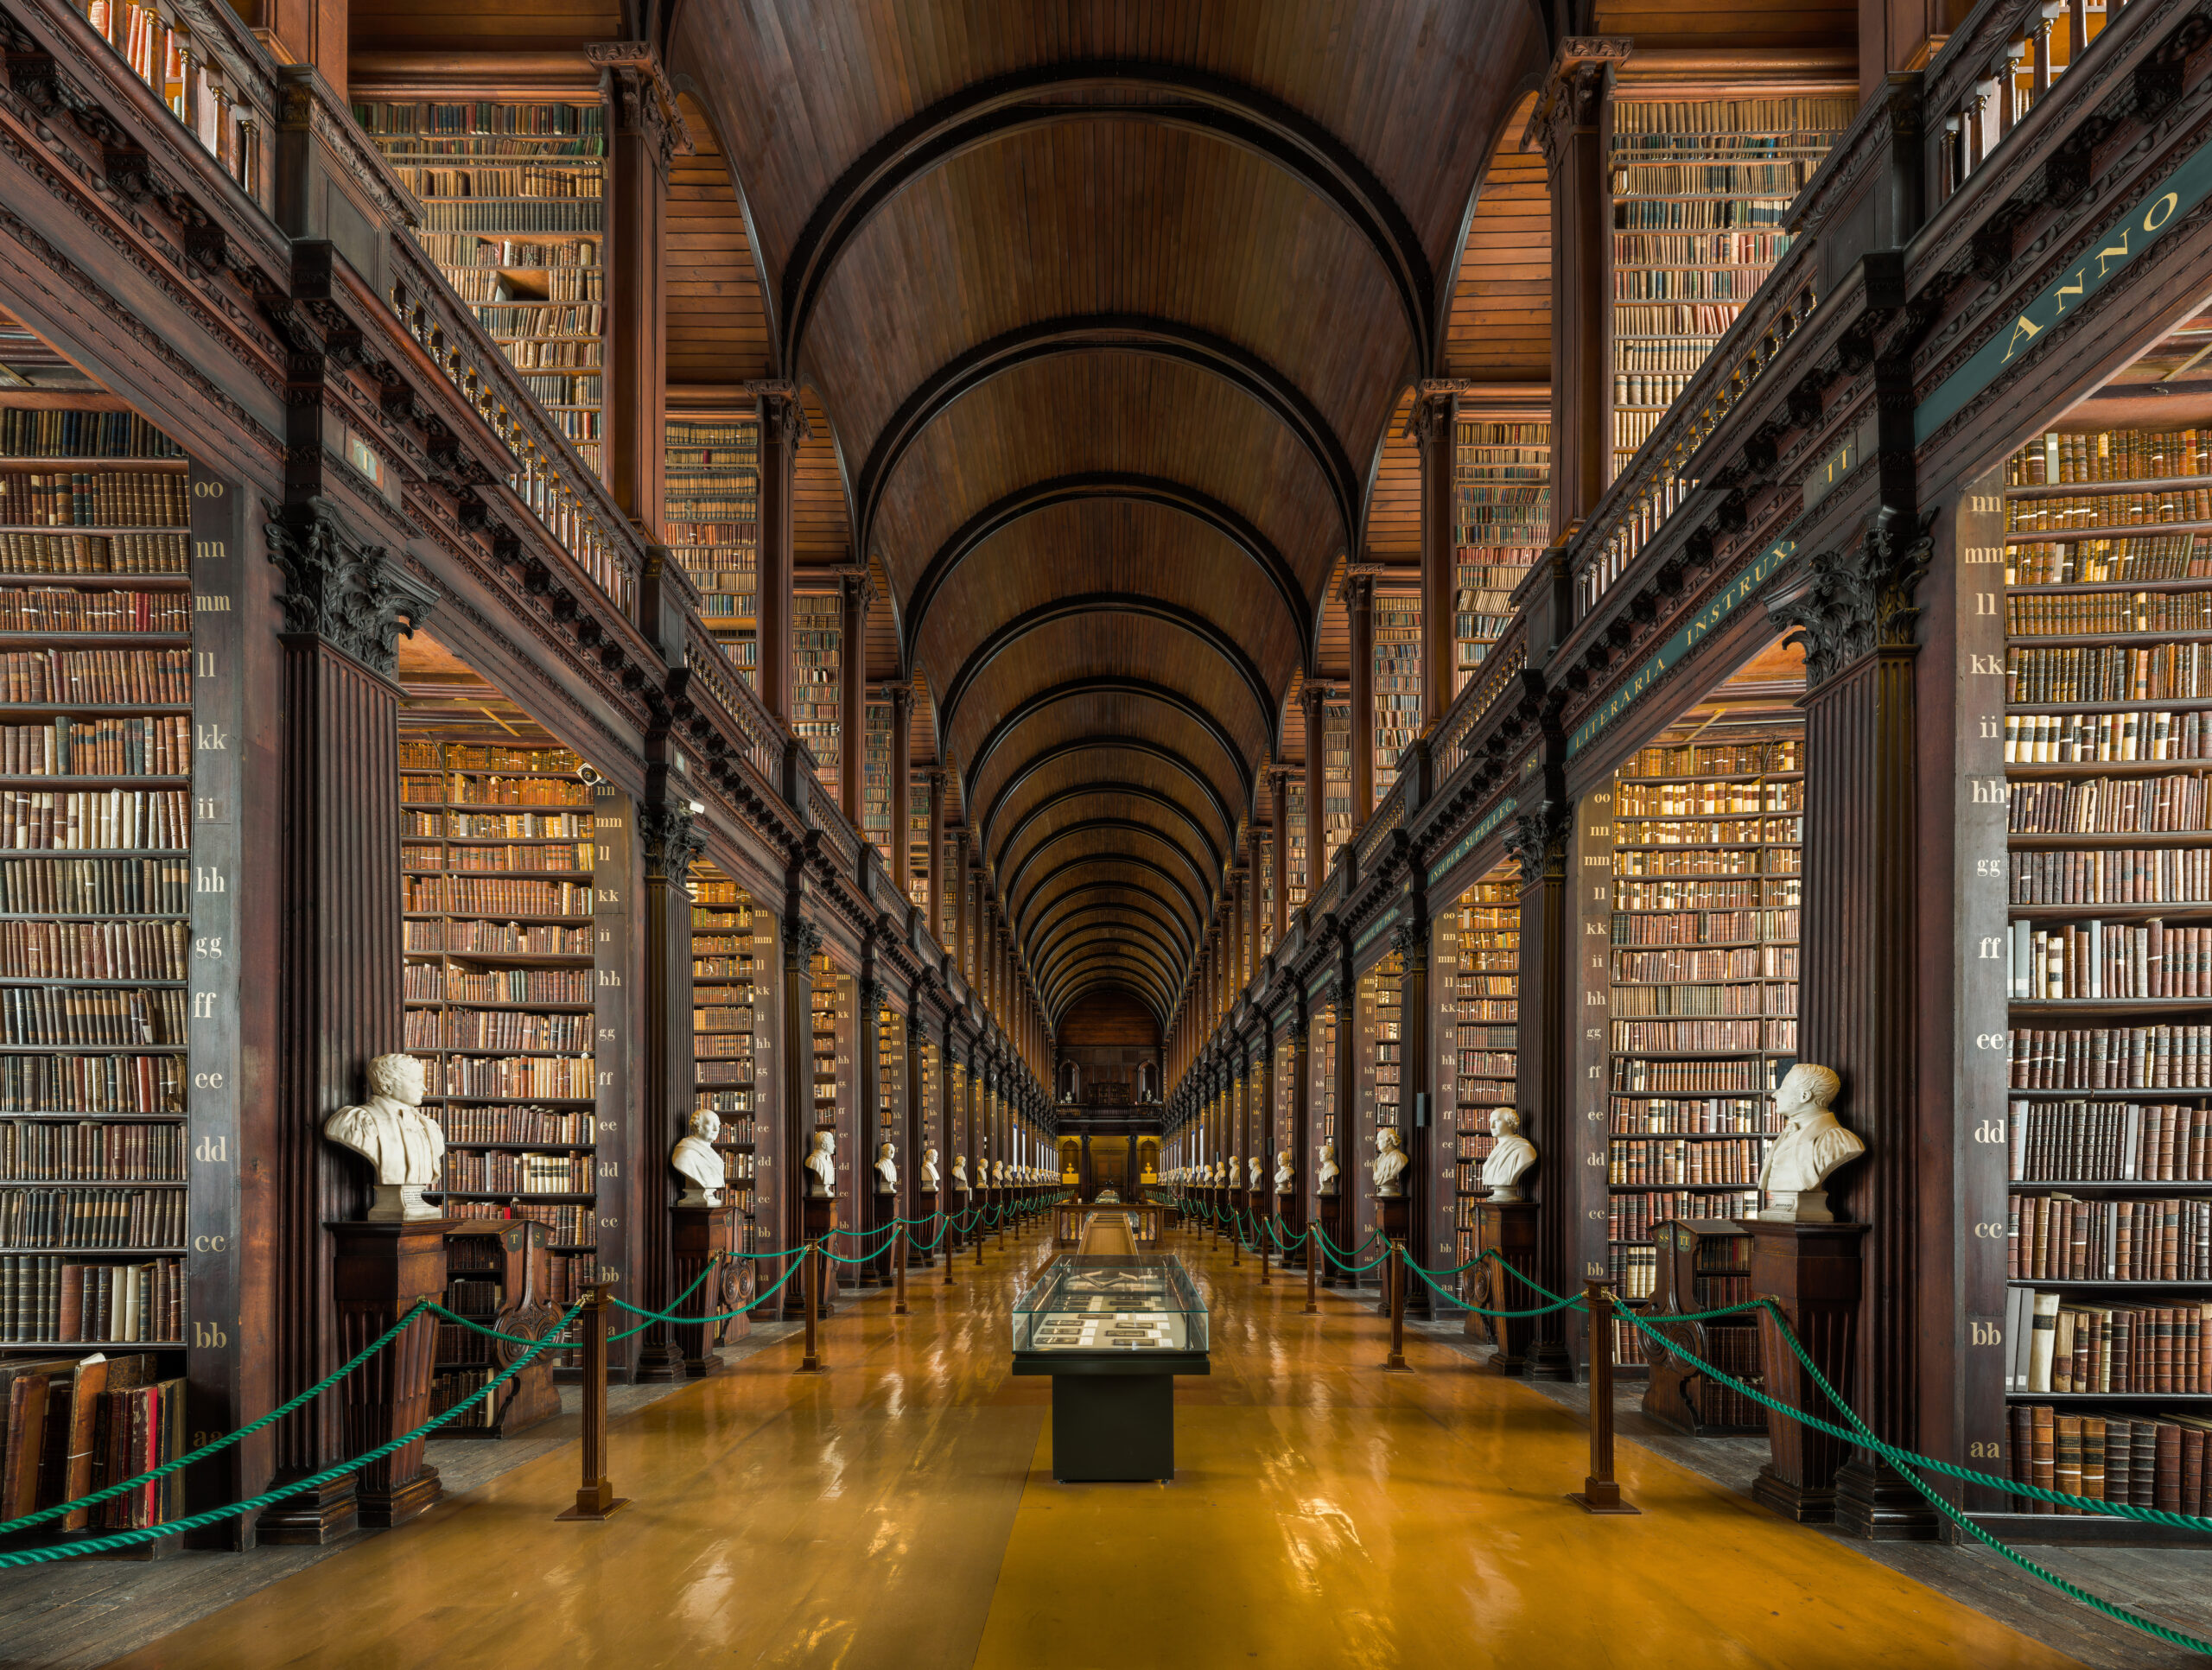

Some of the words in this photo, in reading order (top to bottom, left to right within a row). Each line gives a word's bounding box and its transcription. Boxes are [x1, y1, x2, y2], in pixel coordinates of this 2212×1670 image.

[2001, 192, 2177, 364] ANNO
[1823, 444, 1851, 483] TT
[195, 482, 224, 498] oo
[1970, 495, 2002, 512] nn
[195, 541, 226, 557] nn
[1965, 546, 2005, 563] mm
[195, 594, 232, 611] mm
[1975, 593, 1998, 615] ll
[198, 652, 215, 677] ll
[1970, 655, 2005, 675] kk
[1575, 657, 1665, 749] LITERARIA
[1980, 715, 1999, 738] ii
[197, 725, 226, 749] kk
[597, 786, 615, 796] nn
[1972, 781, 2005, 803] hh
[1595, 794, 1611, 803] oo
[198, 798, 215, 818] ii
[596, 817, 622, 828] mm
[1590, 826, 1610, 836] nn
[598, 846, 610, 860] ll
[1431, 848, 1460, 883] INSUPER
[1585, 855, 1610, 866] mm
[1977, 859, 2001, 878] gg
[196, 867, 225, 892] hh
[598, 890, 619, 902] kk
[1593, 887, 1605, 900] ll
[600, 929, 610, 942] ii
[1586, 923, 1607, 935] kk
[195, 937, 222, 959] gg
[1979, 938, 2001, 959] ff
[756, 959, 764, 970] ll
[1438, 955, 1456, 963] mm
[1592, 955, 1603, 967] ii
[599, 971, 621, 986] hh
[1445, 977, 1453, 987] ll
[194, 993, 216, 1018] ff
[1586, 992, 1606, 1006] hh
[1441, 1004, 1456, 1013] kk
[757, 1012, 765, 1021] ii
[599, 1028, 615, 1041] gg
[1445, 1029, 1452, 1038] ii
[1586, 1028, 1602, 1040] gg
[756, 1038, 771, 1049] hh
[1977, 1033, 2004, 1050] ee
[1441, 1055, 1455, 1065] hh
[757, 1068, 767, 1077] gg
[1588, 1065, 1602, 1078] ff
[194, 1072, 222, 1089] ee
[599, 1072, 613, 1085] ff
[1441, 1083, 1452, 1092] gg
[757, 1093, 766, 1102] ff
[1443, 1110, 1452, 1120] ff
[1588, 1110, 1604, 1121] ee
[600, 1121, 617, 1131] ee
[1974, 1120, 2005, 1144] dd
[195, 1136, 227, 1162] dd
[758, 1156, 772, 1166] dd
[1586, 1152, 1605, 1166] dd
[600, 1162, 618, 1178] dd
[1442, 1168, 1454, 1178] dd
[1589, 1210, 1605, 1220] cc
[601, 1217, 618, 1228] cc
[759, 1227, 771, 1238] bb
[1975, 1222, 2003, 1239] cc
[195, 1235, 226, 1252] cc
[511, 1235, 518, 1244] T
[1659, 1233, 1669, 1243] SS
[1680, 1235, 1689, 1247] TT
[1440, 1243, 1452, 1253] bb
[601, 1267, 619, 1282] bb
[1587, 1262, 1604, 1277] bb
[194, 1323, 226, 1349] bb
[1971, 1323, 2002, 1346] bb
[1970, 1441, 2000, 1459] aa
